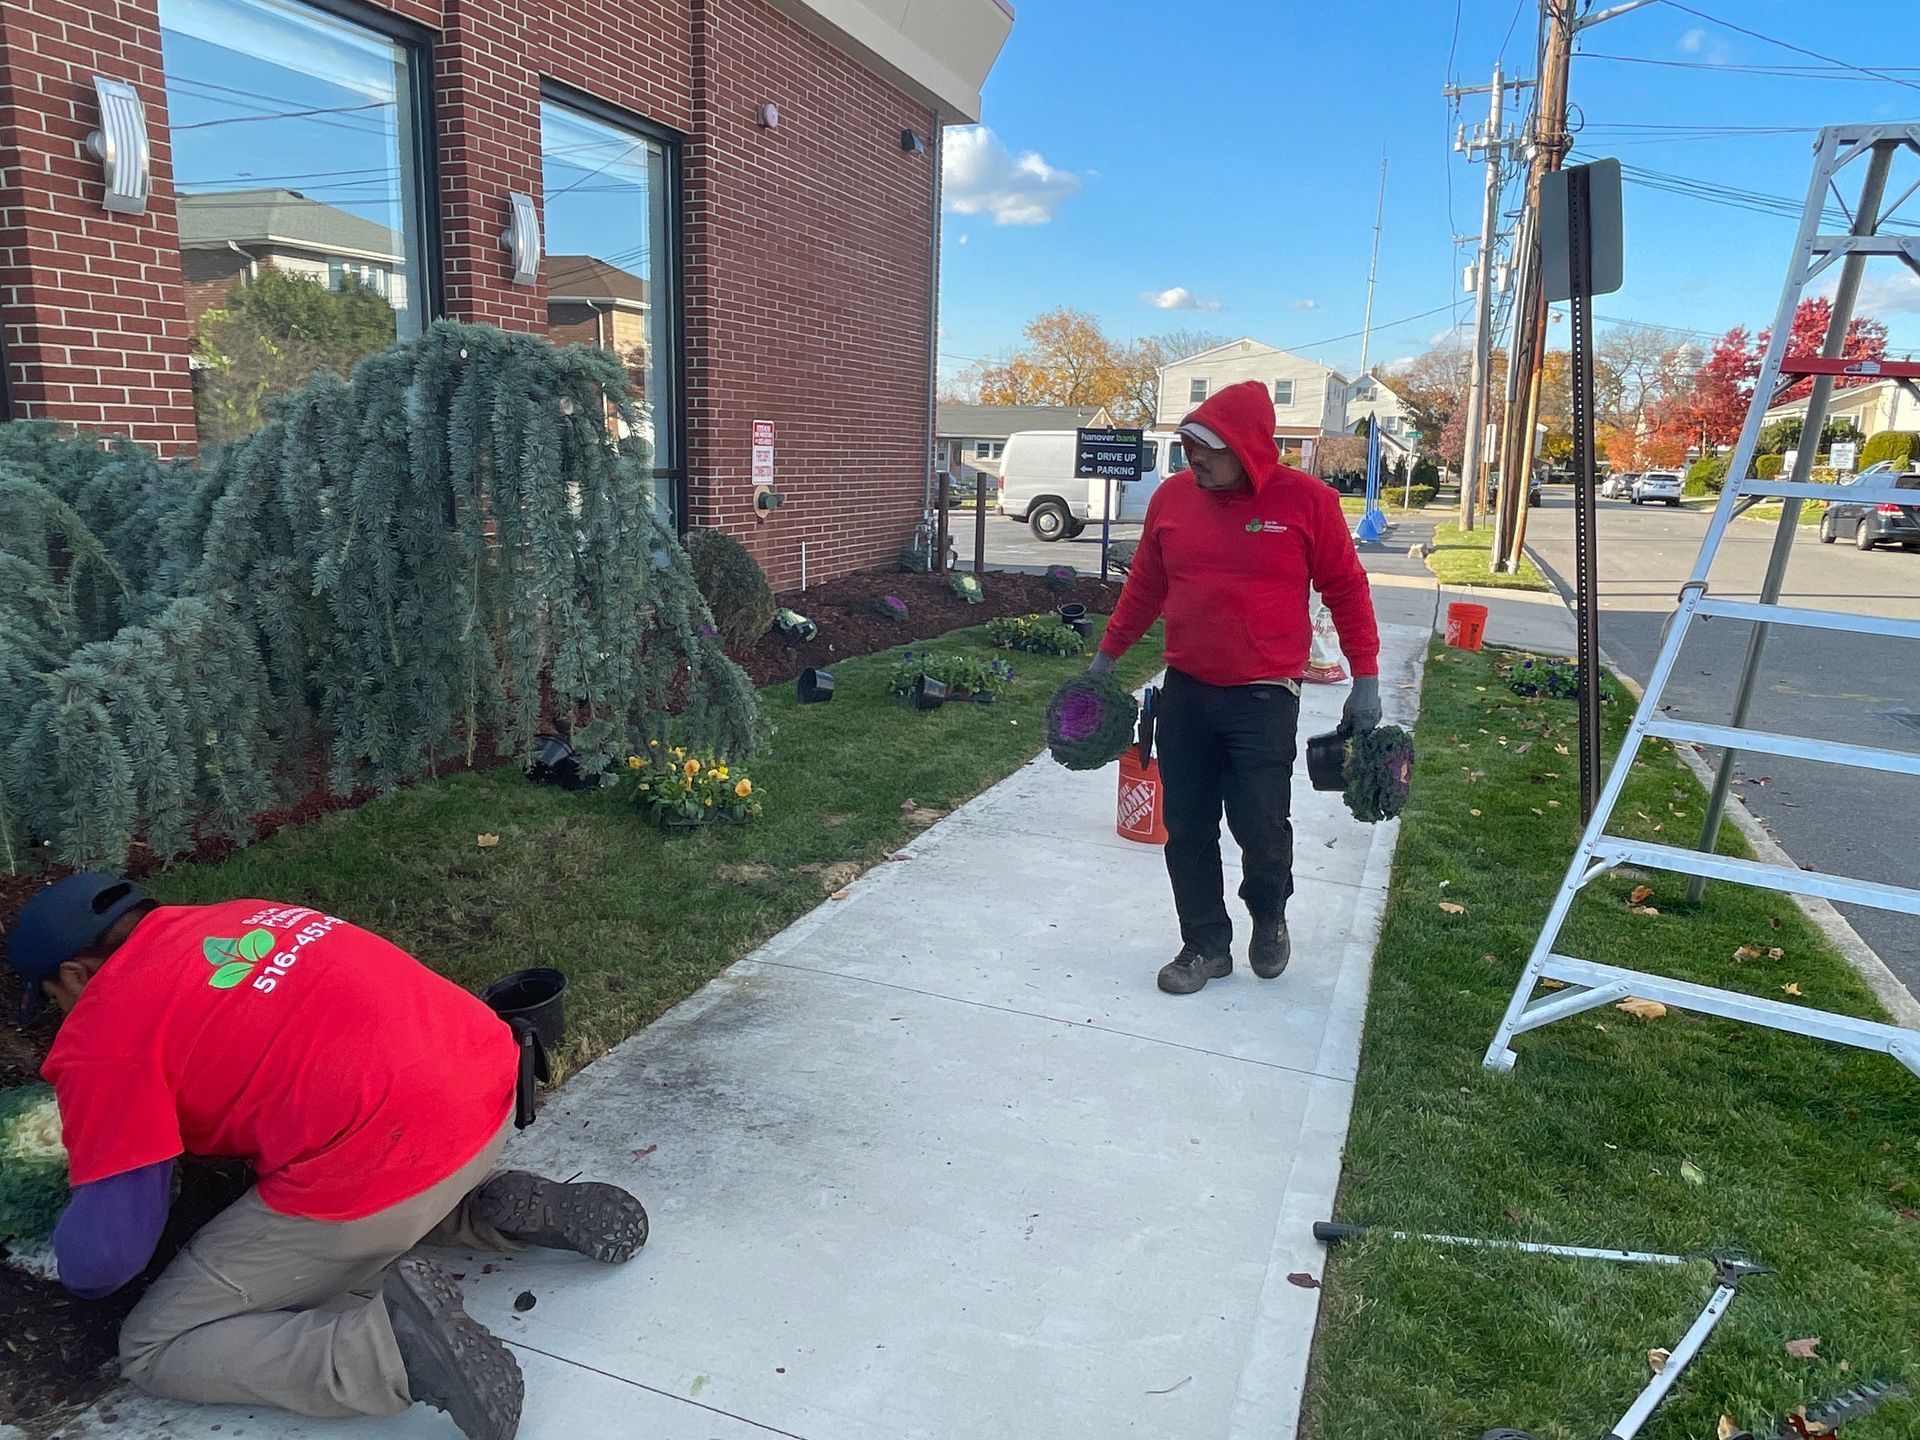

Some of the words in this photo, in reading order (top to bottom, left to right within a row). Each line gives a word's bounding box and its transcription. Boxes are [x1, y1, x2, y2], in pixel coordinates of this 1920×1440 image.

[1081, 432, 1115, 441] hanover
[1116, 434, 1137, 442] bank
[1097, 451, 1123, 461] DRIVE
[1124, 453, 1137, 462] UP
[1096, 465, 1135, 476] PARKING
[1118, 781, 1155, 822] HOME
[1124, 801, 1153, 829] DEPOT
